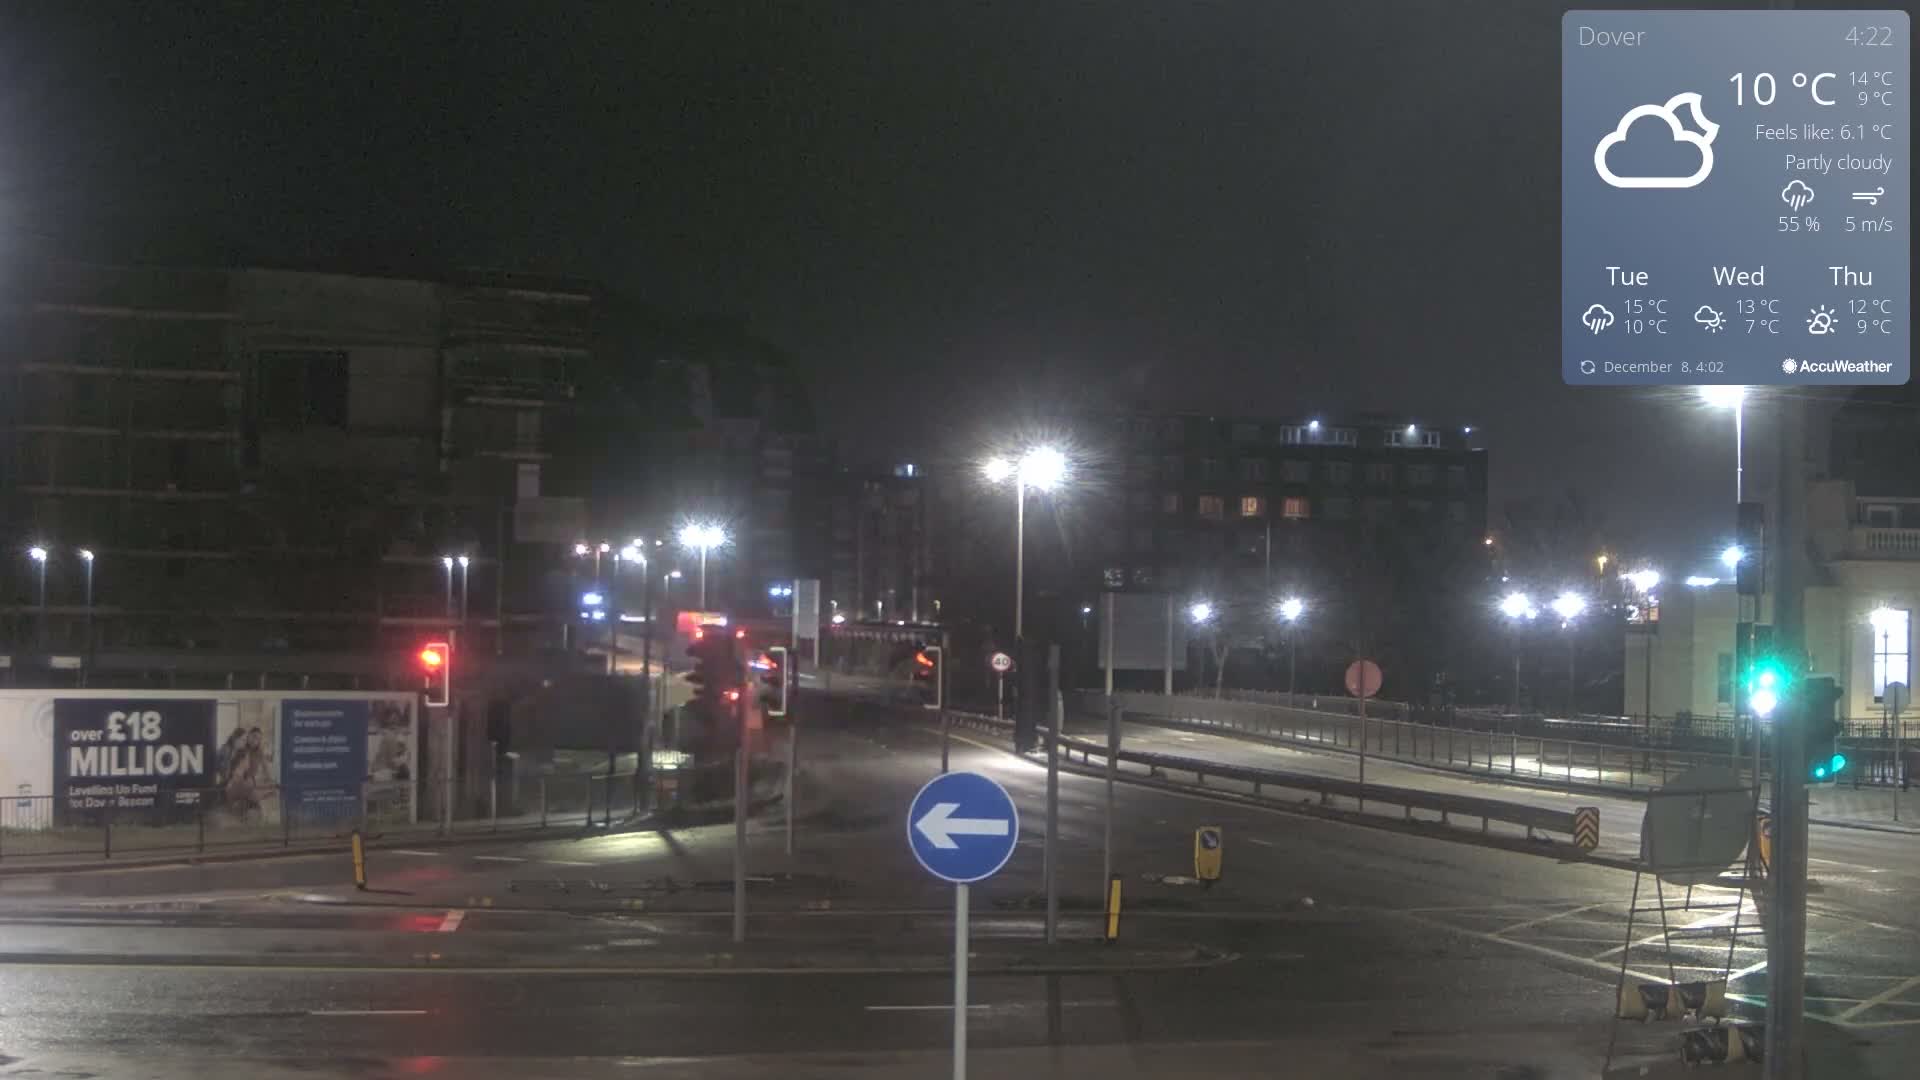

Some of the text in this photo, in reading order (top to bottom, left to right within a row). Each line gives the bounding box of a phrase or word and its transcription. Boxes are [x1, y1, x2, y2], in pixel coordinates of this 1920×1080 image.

[71, 710, 161, 741] over £18
[70, 744, 203, 776] MILLION
